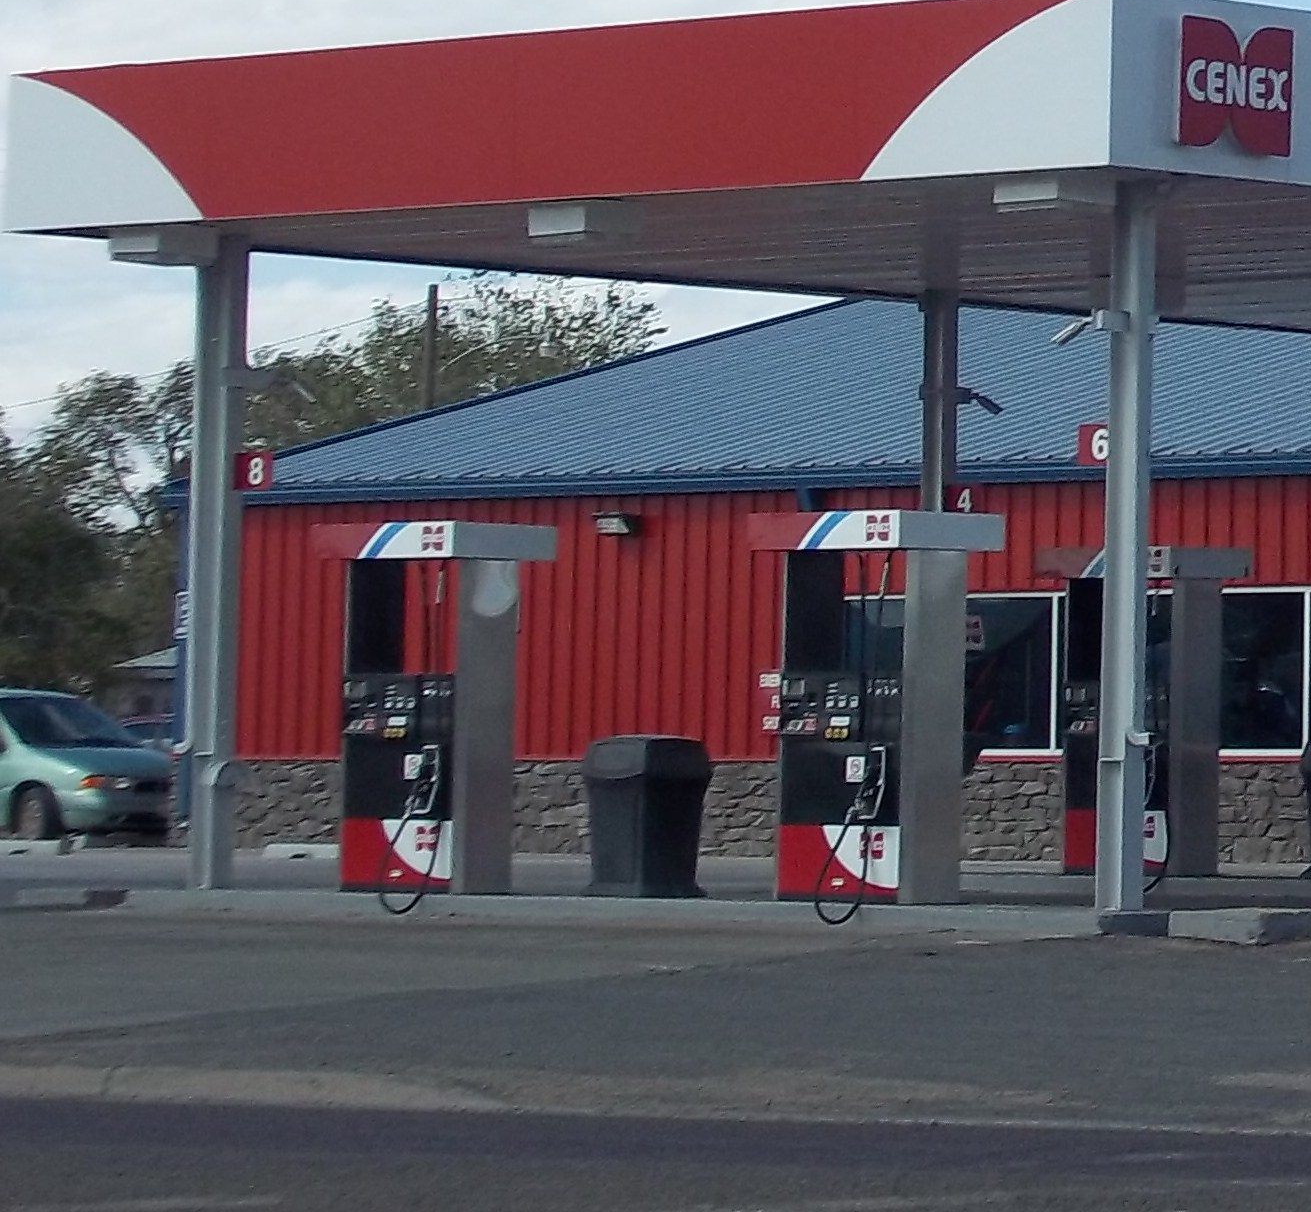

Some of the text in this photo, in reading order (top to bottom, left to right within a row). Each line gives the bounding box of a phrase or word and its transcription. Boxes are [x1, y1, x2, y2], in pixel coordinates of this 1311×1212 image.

[1185, 58, 1290, 112] CENEX
[1091, 428, 1109, 461] 6
[248, 457, 264, 485] 8
[956, 488, 972, 513] 4
